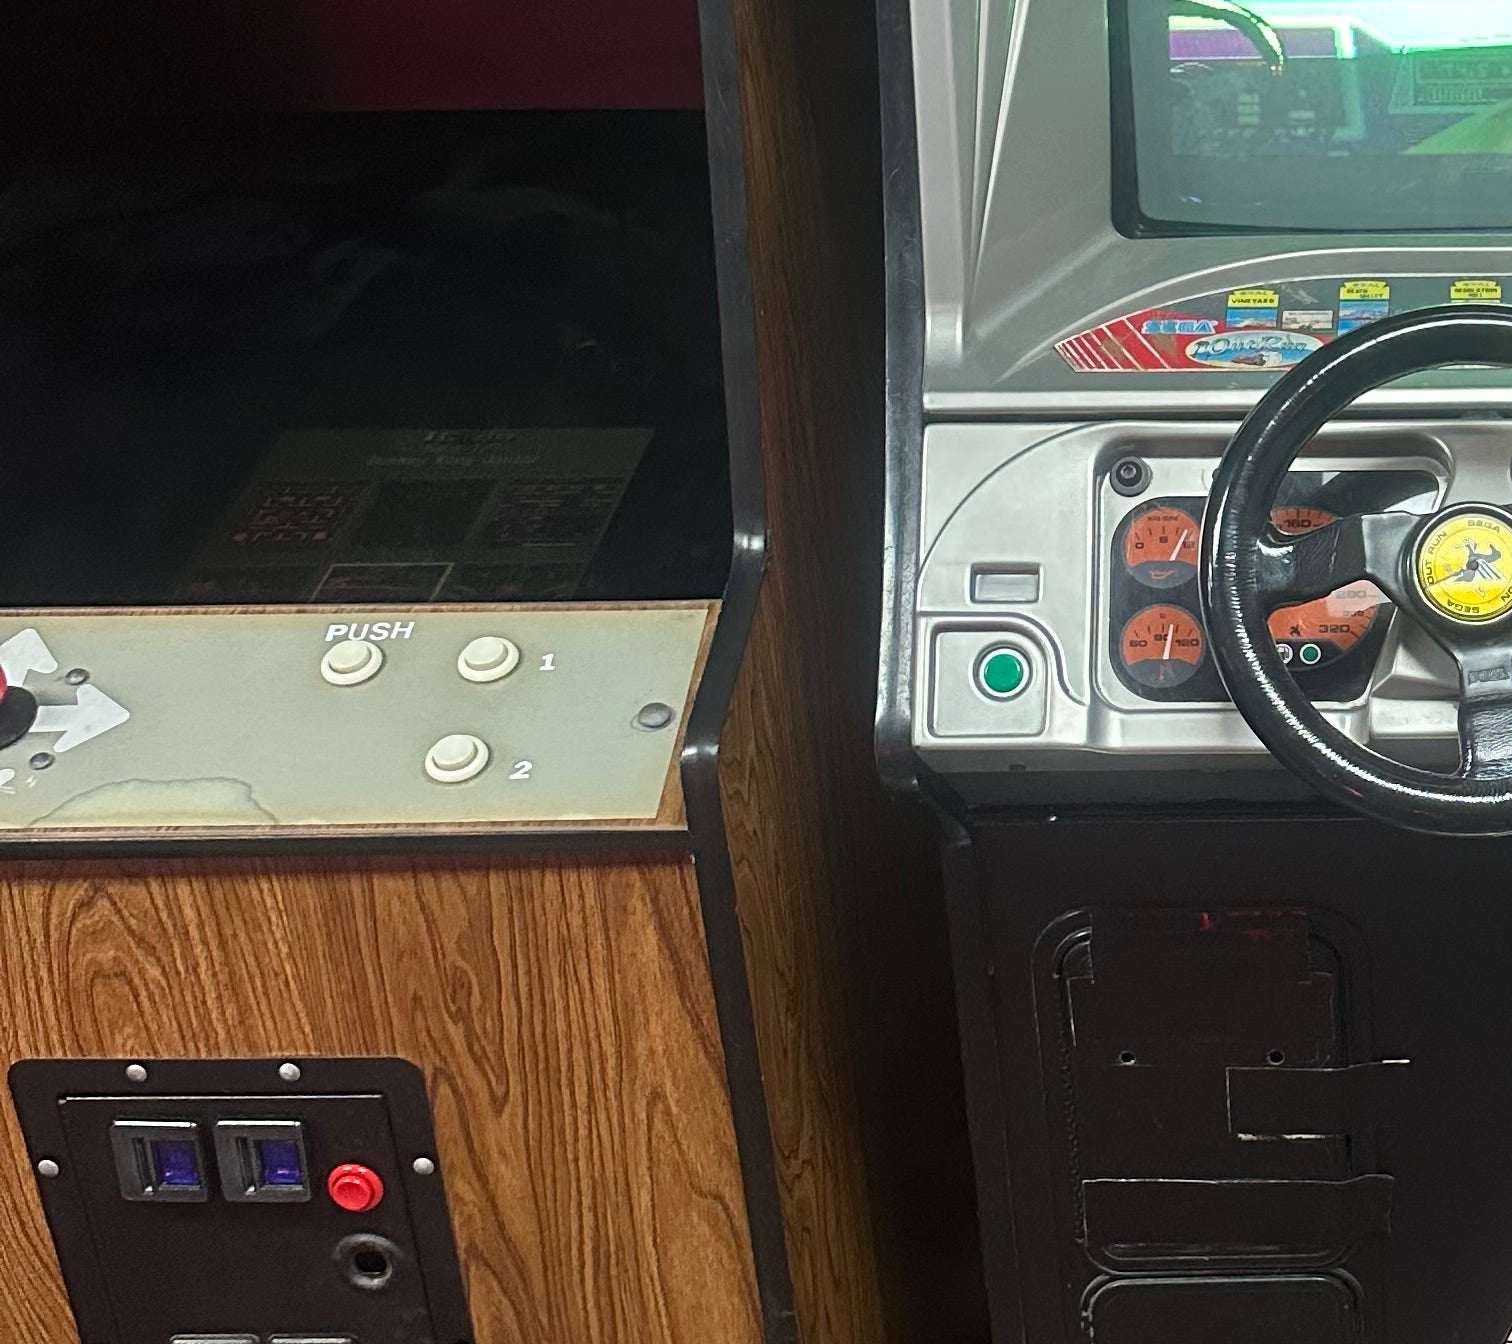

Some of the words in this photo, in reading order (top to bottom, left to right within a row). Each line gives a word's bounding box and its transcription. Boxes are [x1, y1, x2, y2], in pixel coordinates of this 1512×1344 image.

[1142, 319, 1217, 334] SEGA
[1467, 519, 1501, 533] SEGA
[1427, 531, 1448, 555] RUN
[1425, 559, 1437, 585] OUT
[1446, 599, 1480, 614] SEGA
[325, 621, 416, 642] PUSH
[1318, 624, 1351, 634] 320
[539, 653, 555, 671] 1
[509, 761, 533, 780] 2
